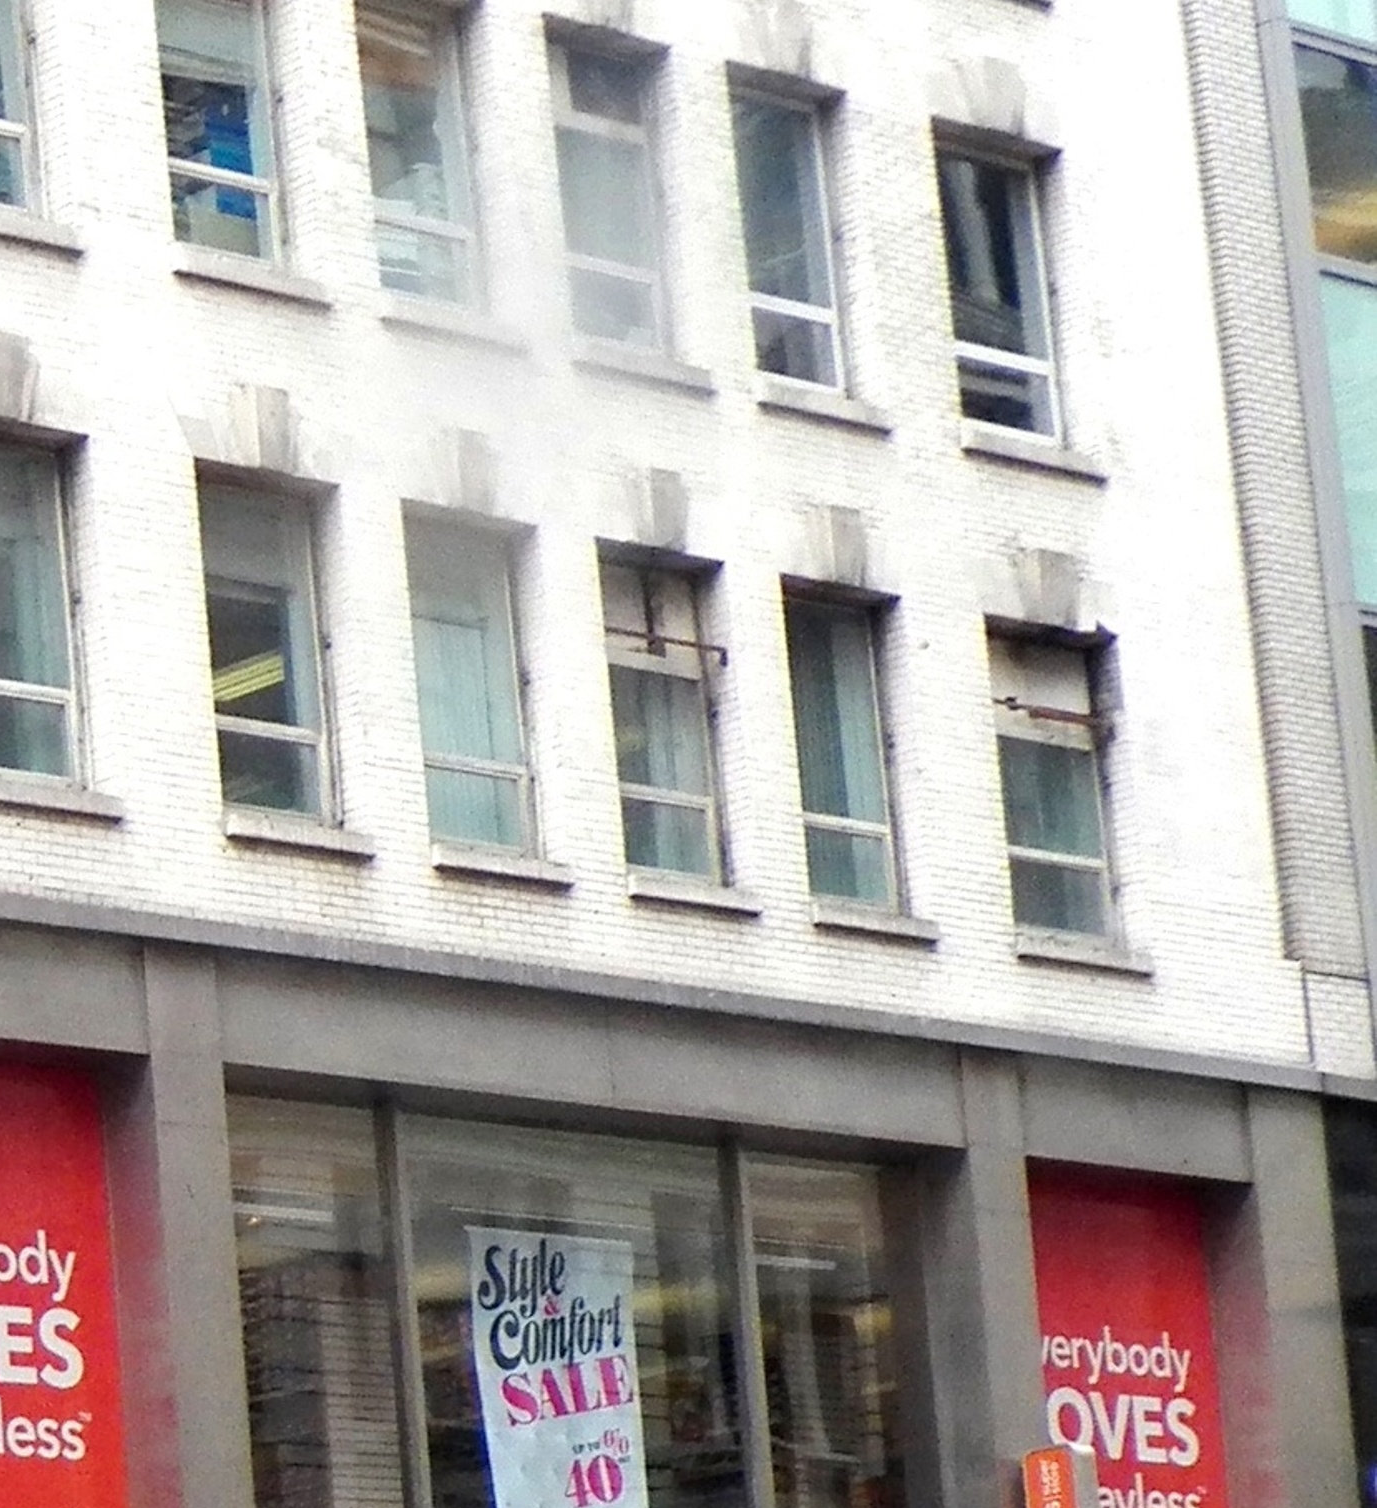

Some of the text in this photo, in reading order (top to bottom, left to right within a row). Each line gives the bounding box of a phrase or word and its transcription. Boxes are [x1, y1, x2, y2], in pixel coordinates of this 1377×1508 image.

[477, 1237, 567, 1318] Style
[489, 1293, 623, 1371] Comfort
[499, 1355, 635, 1428] SALE
[1047, 1385, 1201, 1469] OVES
[564, 1453, 623, 1508] 40
